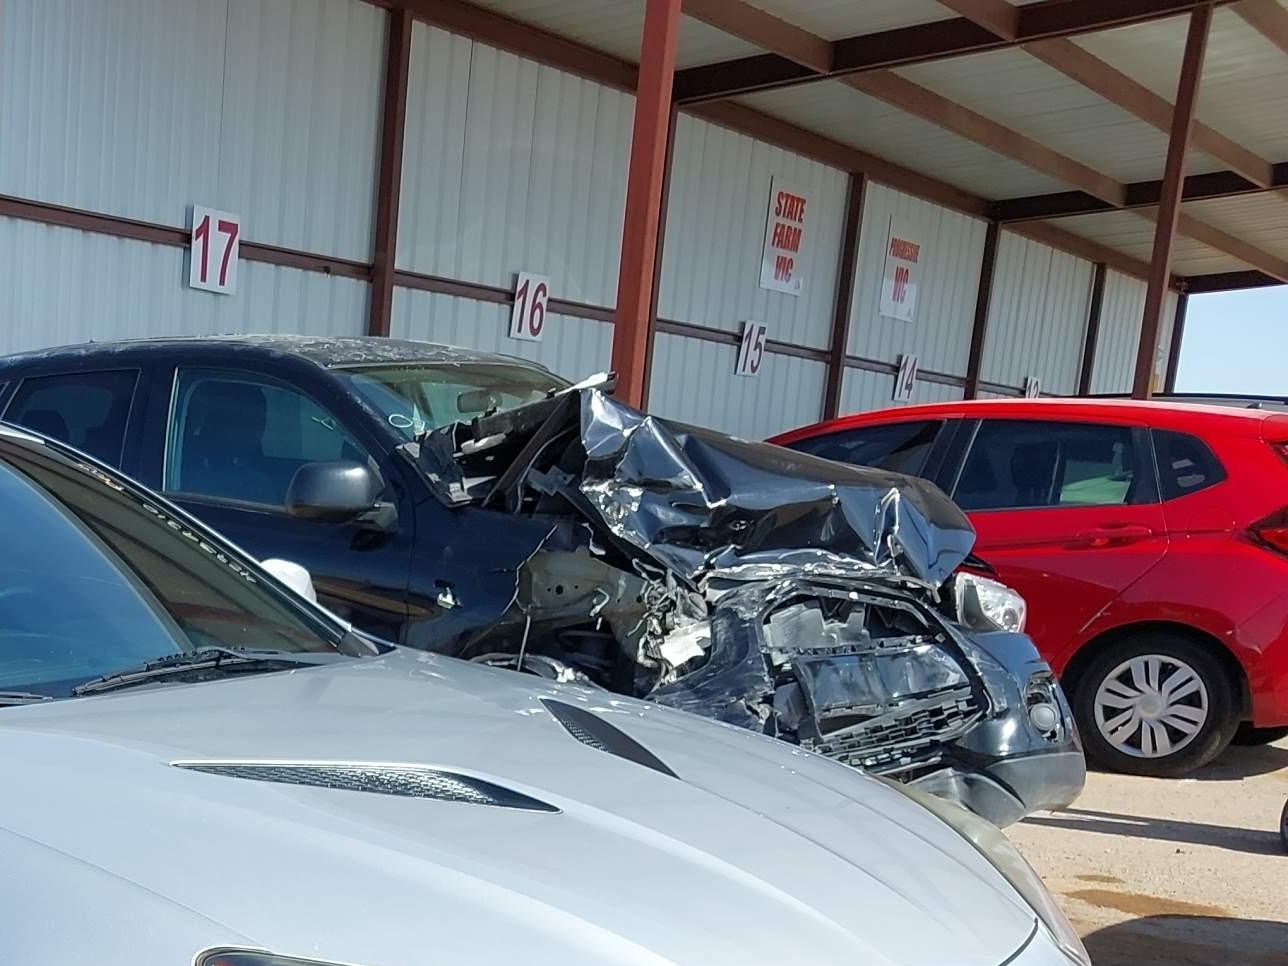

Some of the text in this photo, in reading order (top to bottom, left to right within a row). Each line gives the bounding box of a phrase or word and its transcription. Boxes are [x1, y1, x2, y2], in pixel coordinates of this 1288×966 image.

[775, 191, 806, 223] STATE
[195, 214, 239, 287] 17
[772, 222, 802, 253] FARM
[517, 279, 547, 337] 16
[742, 324, 766, 374] 15
[898, 356, 917, 400] 14
